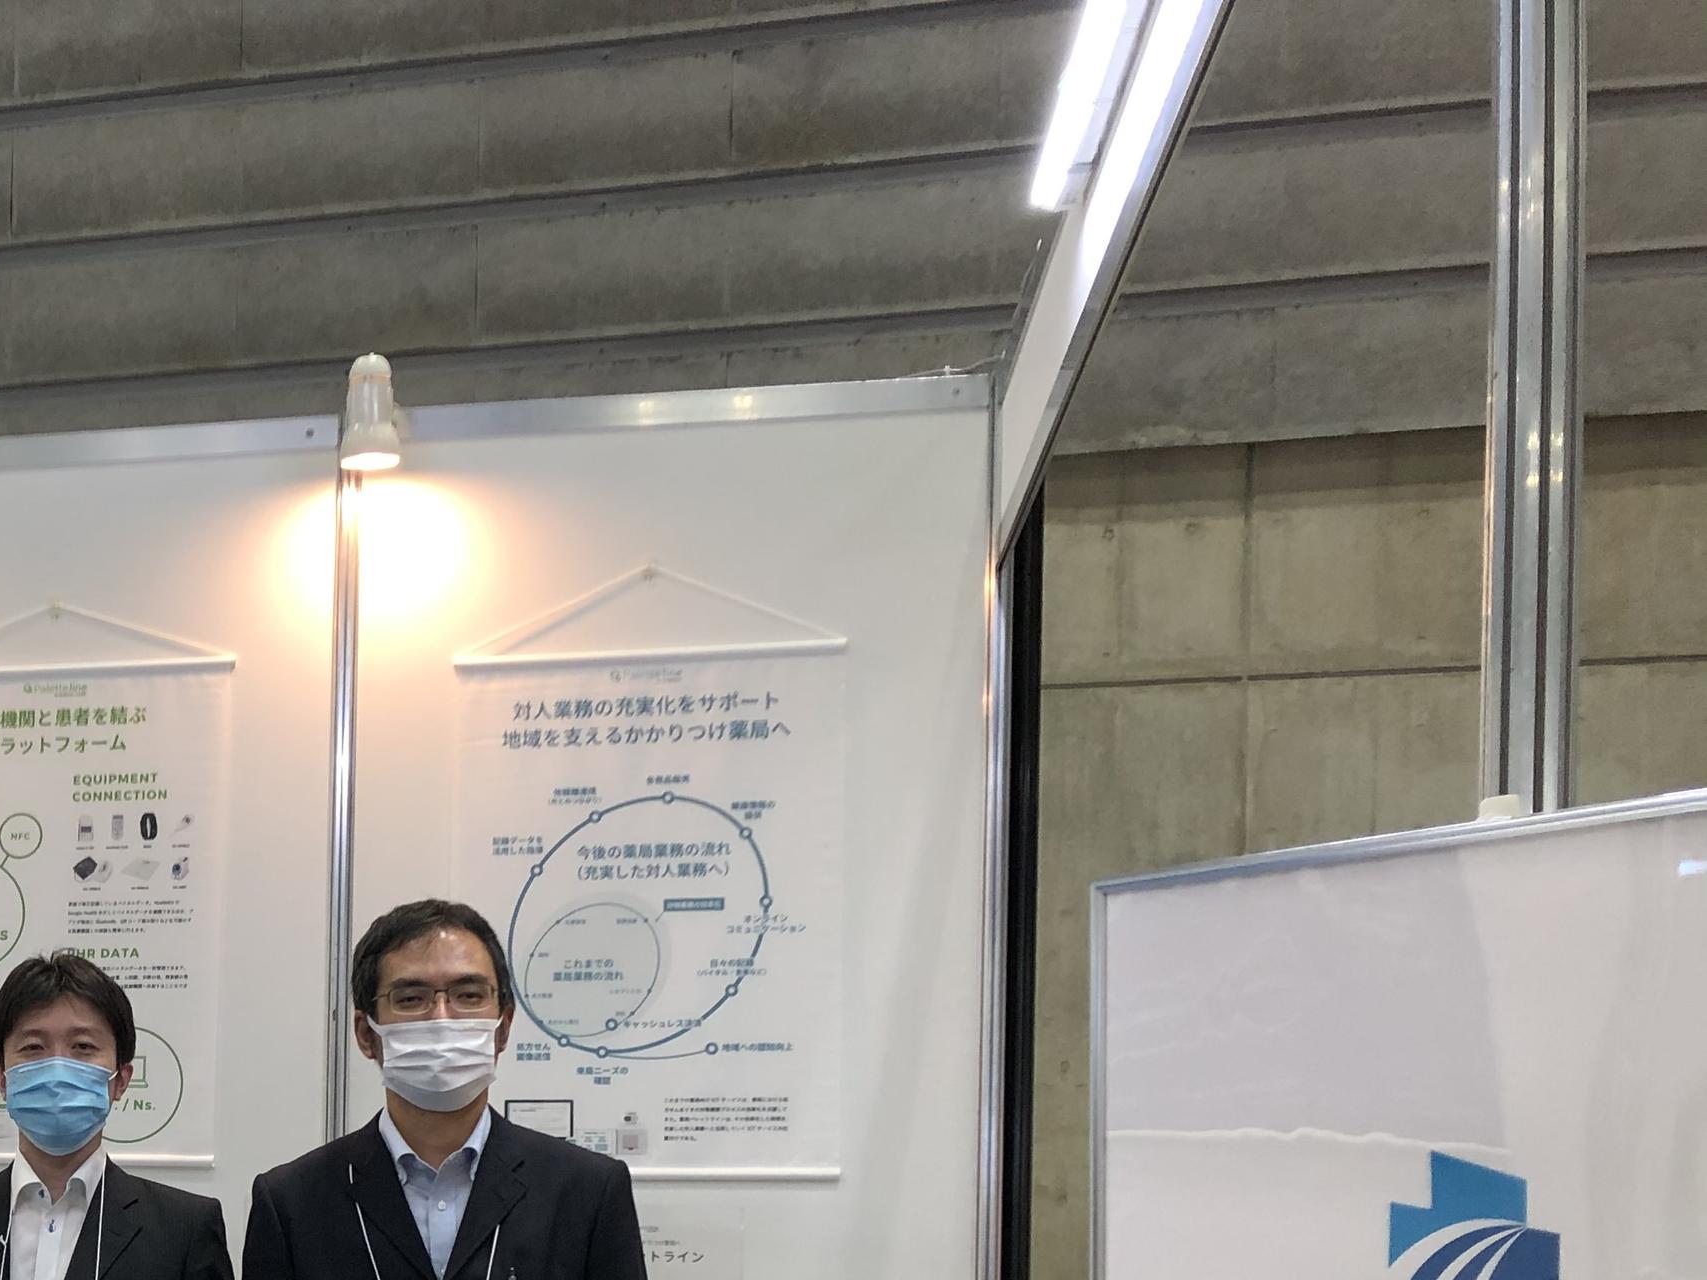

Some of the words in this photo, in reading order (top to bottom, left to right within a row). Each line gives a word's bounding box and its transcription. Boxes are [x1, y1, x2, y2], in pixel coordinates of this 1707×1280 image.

[513, 691, 779, 721] 対人業務の充実化をサポート
[502, 719, 791, 750] 地域を支えるかかりつけ薬局へ
[73, 772, 158, 786] EQUIPMENT
[72, 789, 168, 802] CONNECTION
[11, 832, 30, 841] NFC
[99, 948, 139, 959] DATA
[564, 959, 614, 969] これまでの
[133, 1099, 156, 1111] Ns.
